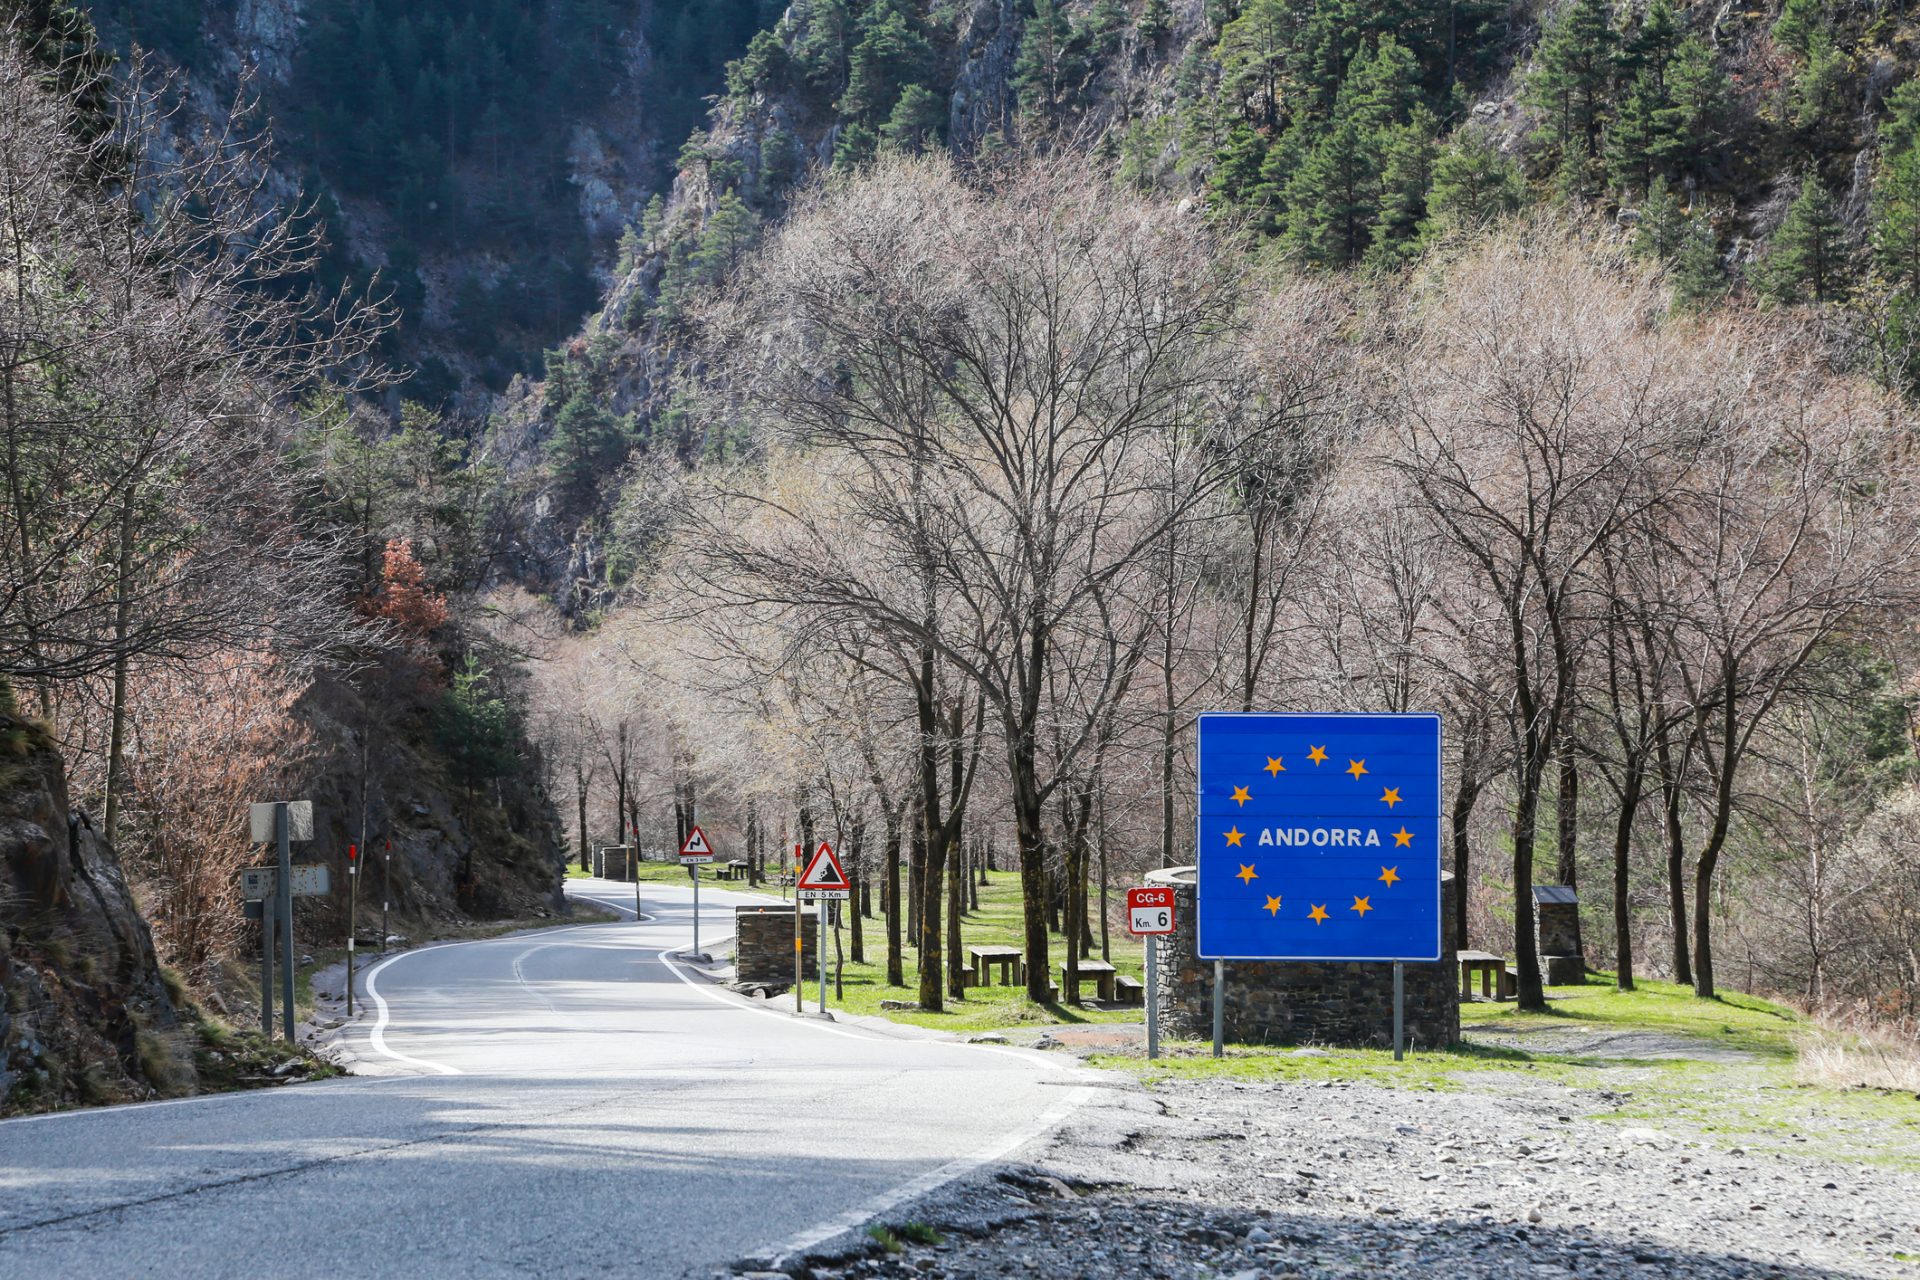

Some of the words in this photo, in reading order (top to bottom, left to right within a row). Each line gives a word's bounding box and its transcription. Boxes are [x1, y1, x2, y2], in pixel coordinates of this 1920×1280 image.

[1258, 828, 1381, 846] ANDORRA
[1136, 893, 1165, 903] CG-6
[1135, 917, 1152, 928] Km.
[1157, 911, 1168, 926] 6
